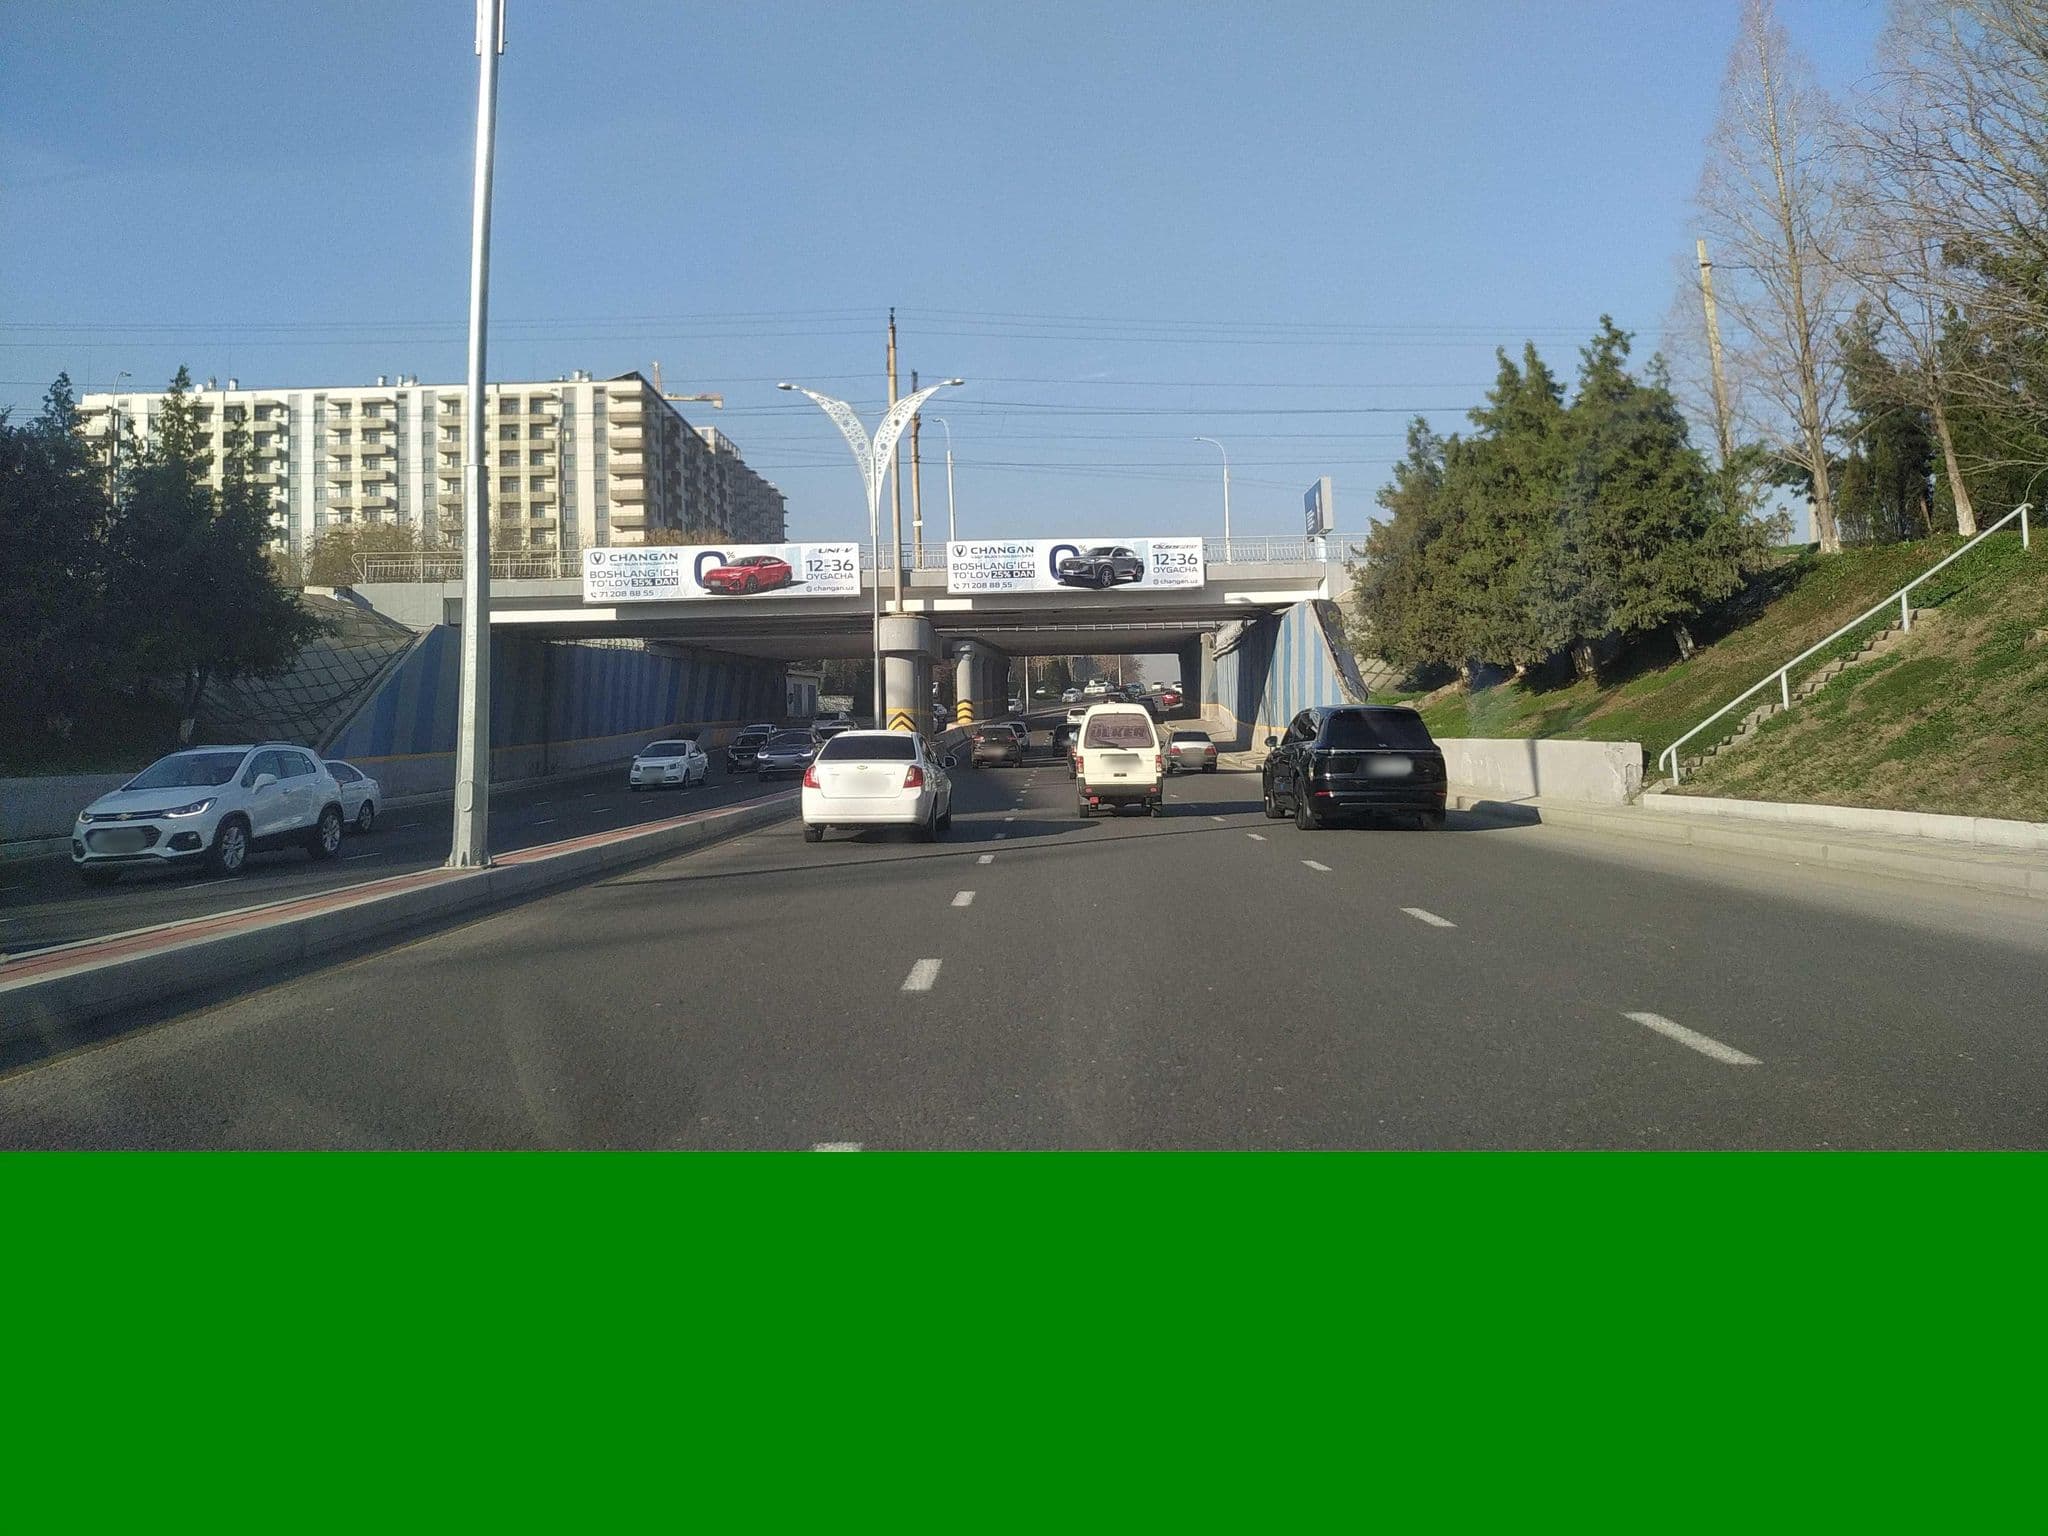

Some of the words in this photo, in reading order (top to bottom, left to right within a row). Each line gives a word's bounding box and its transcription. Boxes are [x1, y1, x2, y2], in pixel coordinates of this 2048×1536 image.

[970, 546, 1034, 554] CHANGAN
[609, 553, 678, 562] CHANGAN
[1152, 553, 1198, 565] 12-36
[806, 559, 854, 571] 12-36
[806, 573, 854, 581] OYGACHA
[1013, 570, 1034, 578] DAN
[655, 578, 678, 586] DAN
